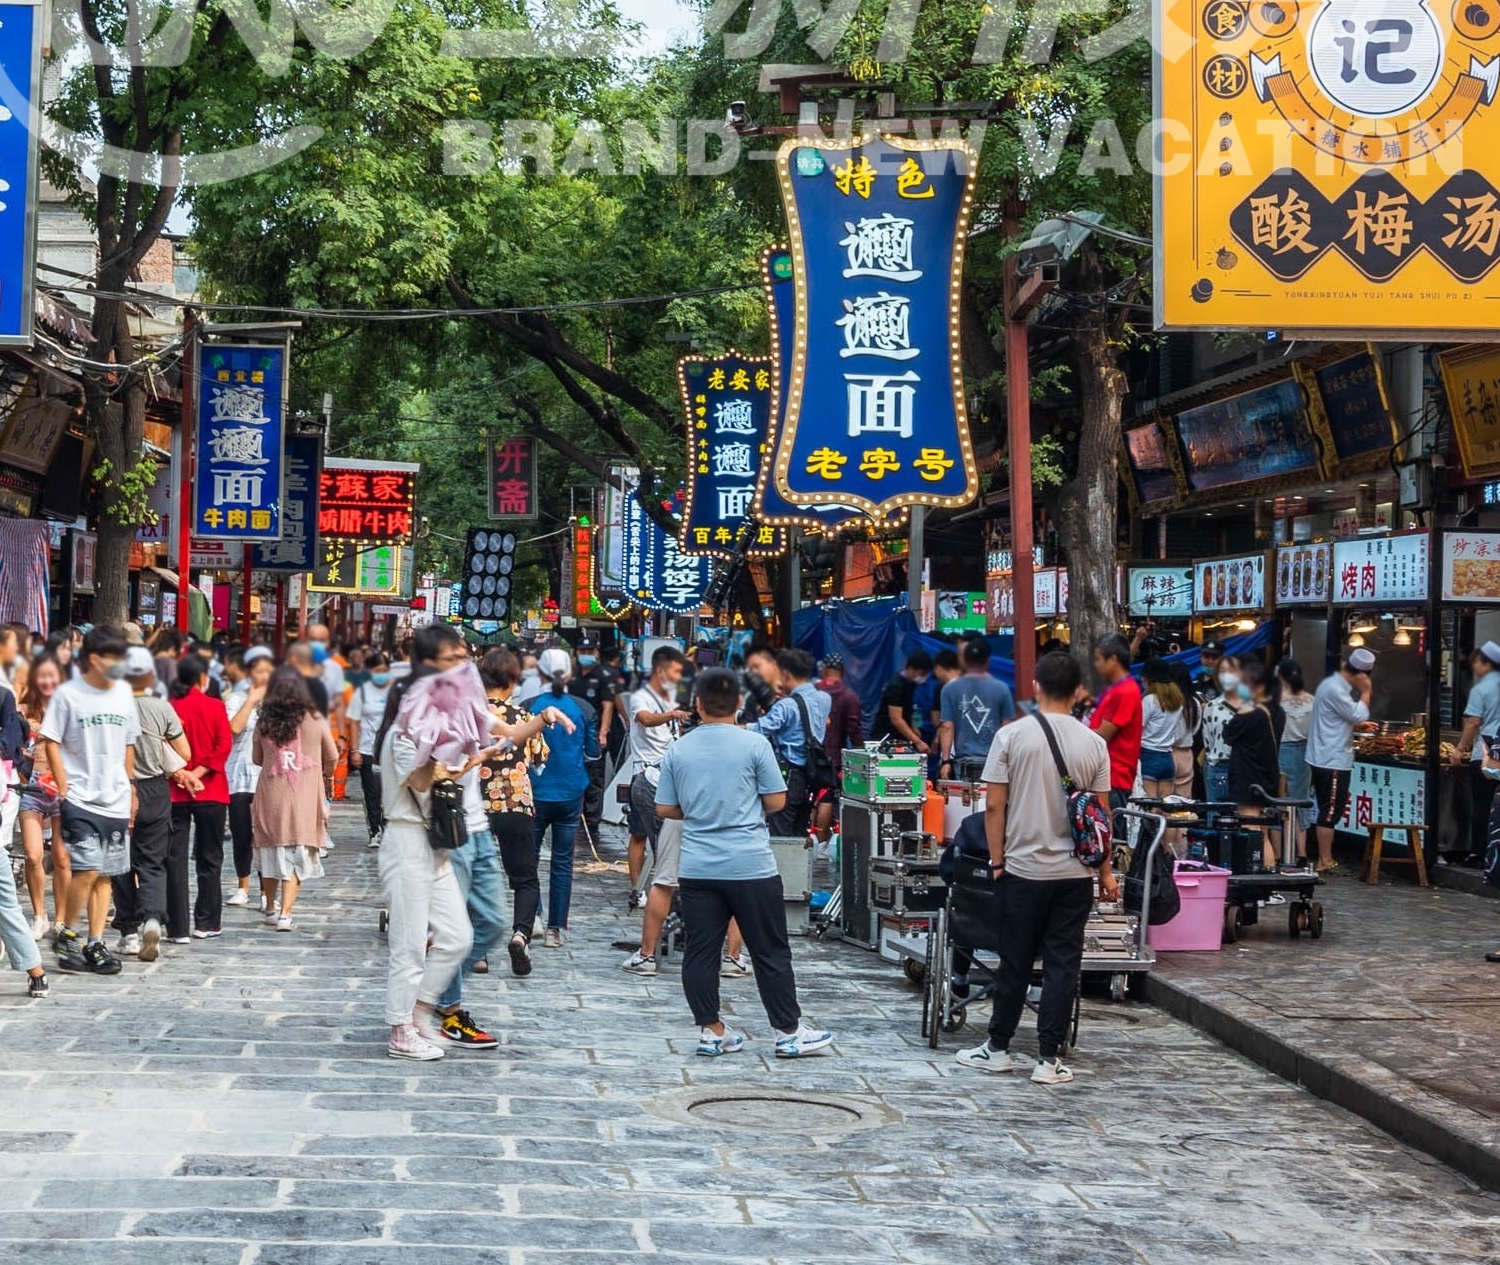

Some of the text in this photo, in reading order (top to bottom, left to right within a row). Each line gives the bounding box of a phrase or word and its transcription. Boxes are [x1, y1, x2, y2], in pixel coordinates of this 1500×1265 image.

[834, 156, 936, 200] 特色
[708, 367, 771, 391] 老安家
[806, 446, 955, 481] 老字号
[203, 508, 272, 530] 牛肉面
[1340, 560, 1377, 600] 烤肉
[282, 750, 301, 771] R
